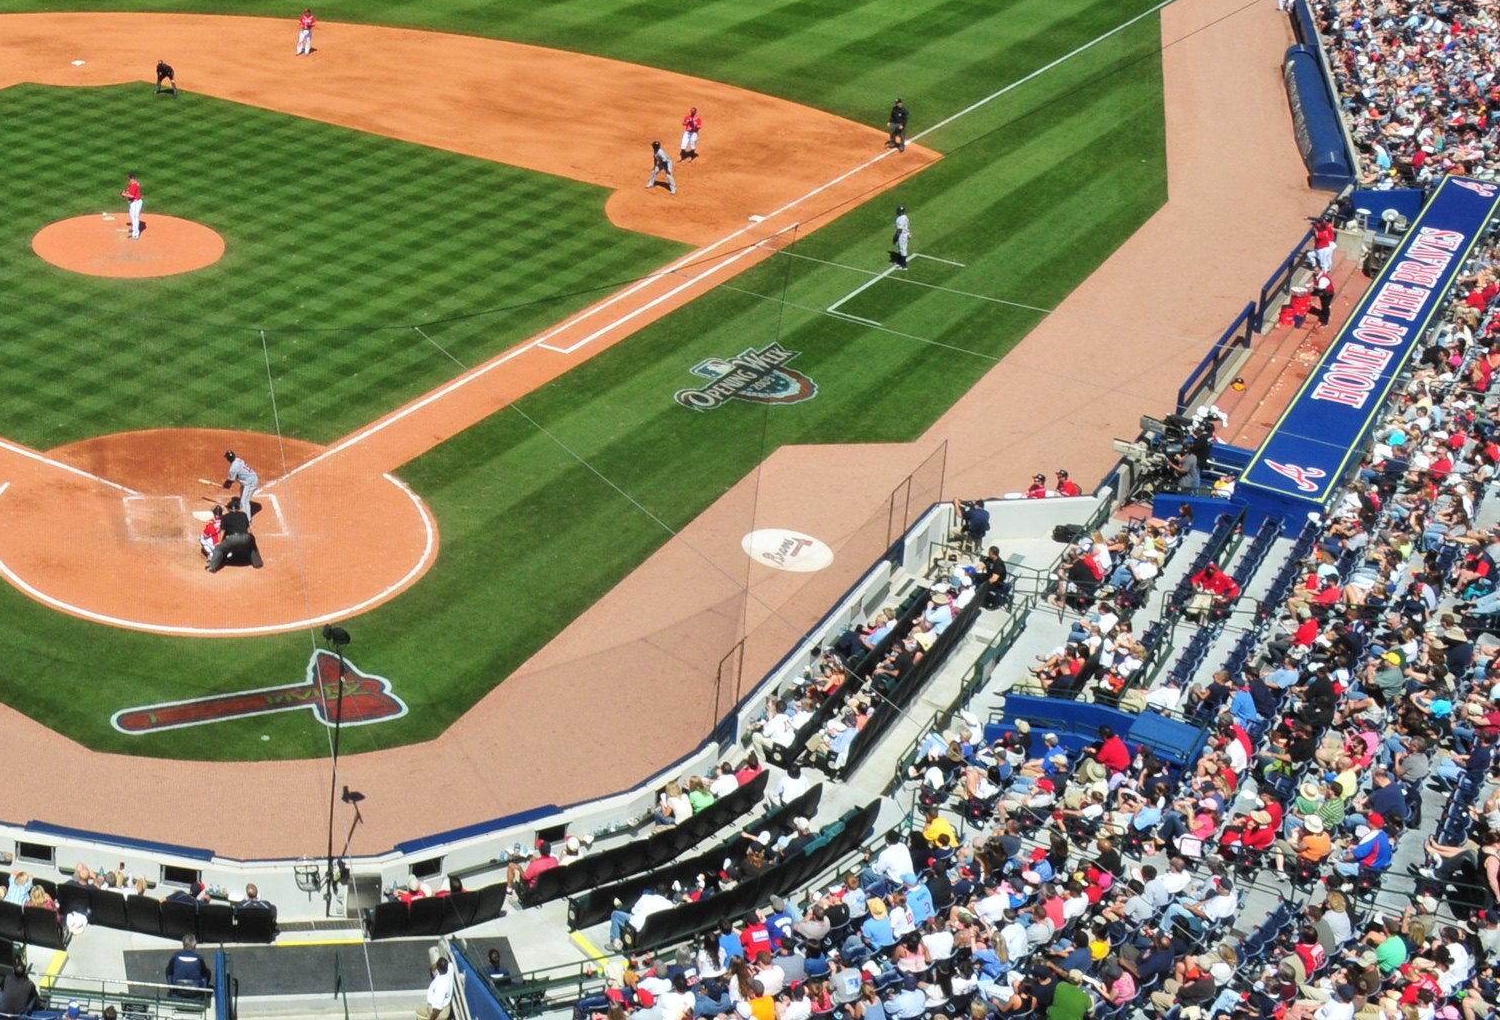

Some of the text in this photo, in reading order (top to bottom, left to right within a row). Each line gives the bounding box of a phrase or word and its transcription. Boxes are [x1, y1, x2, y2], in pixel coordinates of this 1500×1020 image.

[1393, 226, 1465, 288] BRAVES
[1371, 282, 1430, 321] THE
[1352, 315, 1409, 347] OF
[680, 346, 794, 407] OPENING WEEK
[1311, 341, 1395, 409] HOME
[923, 902, 932, 915] 3
